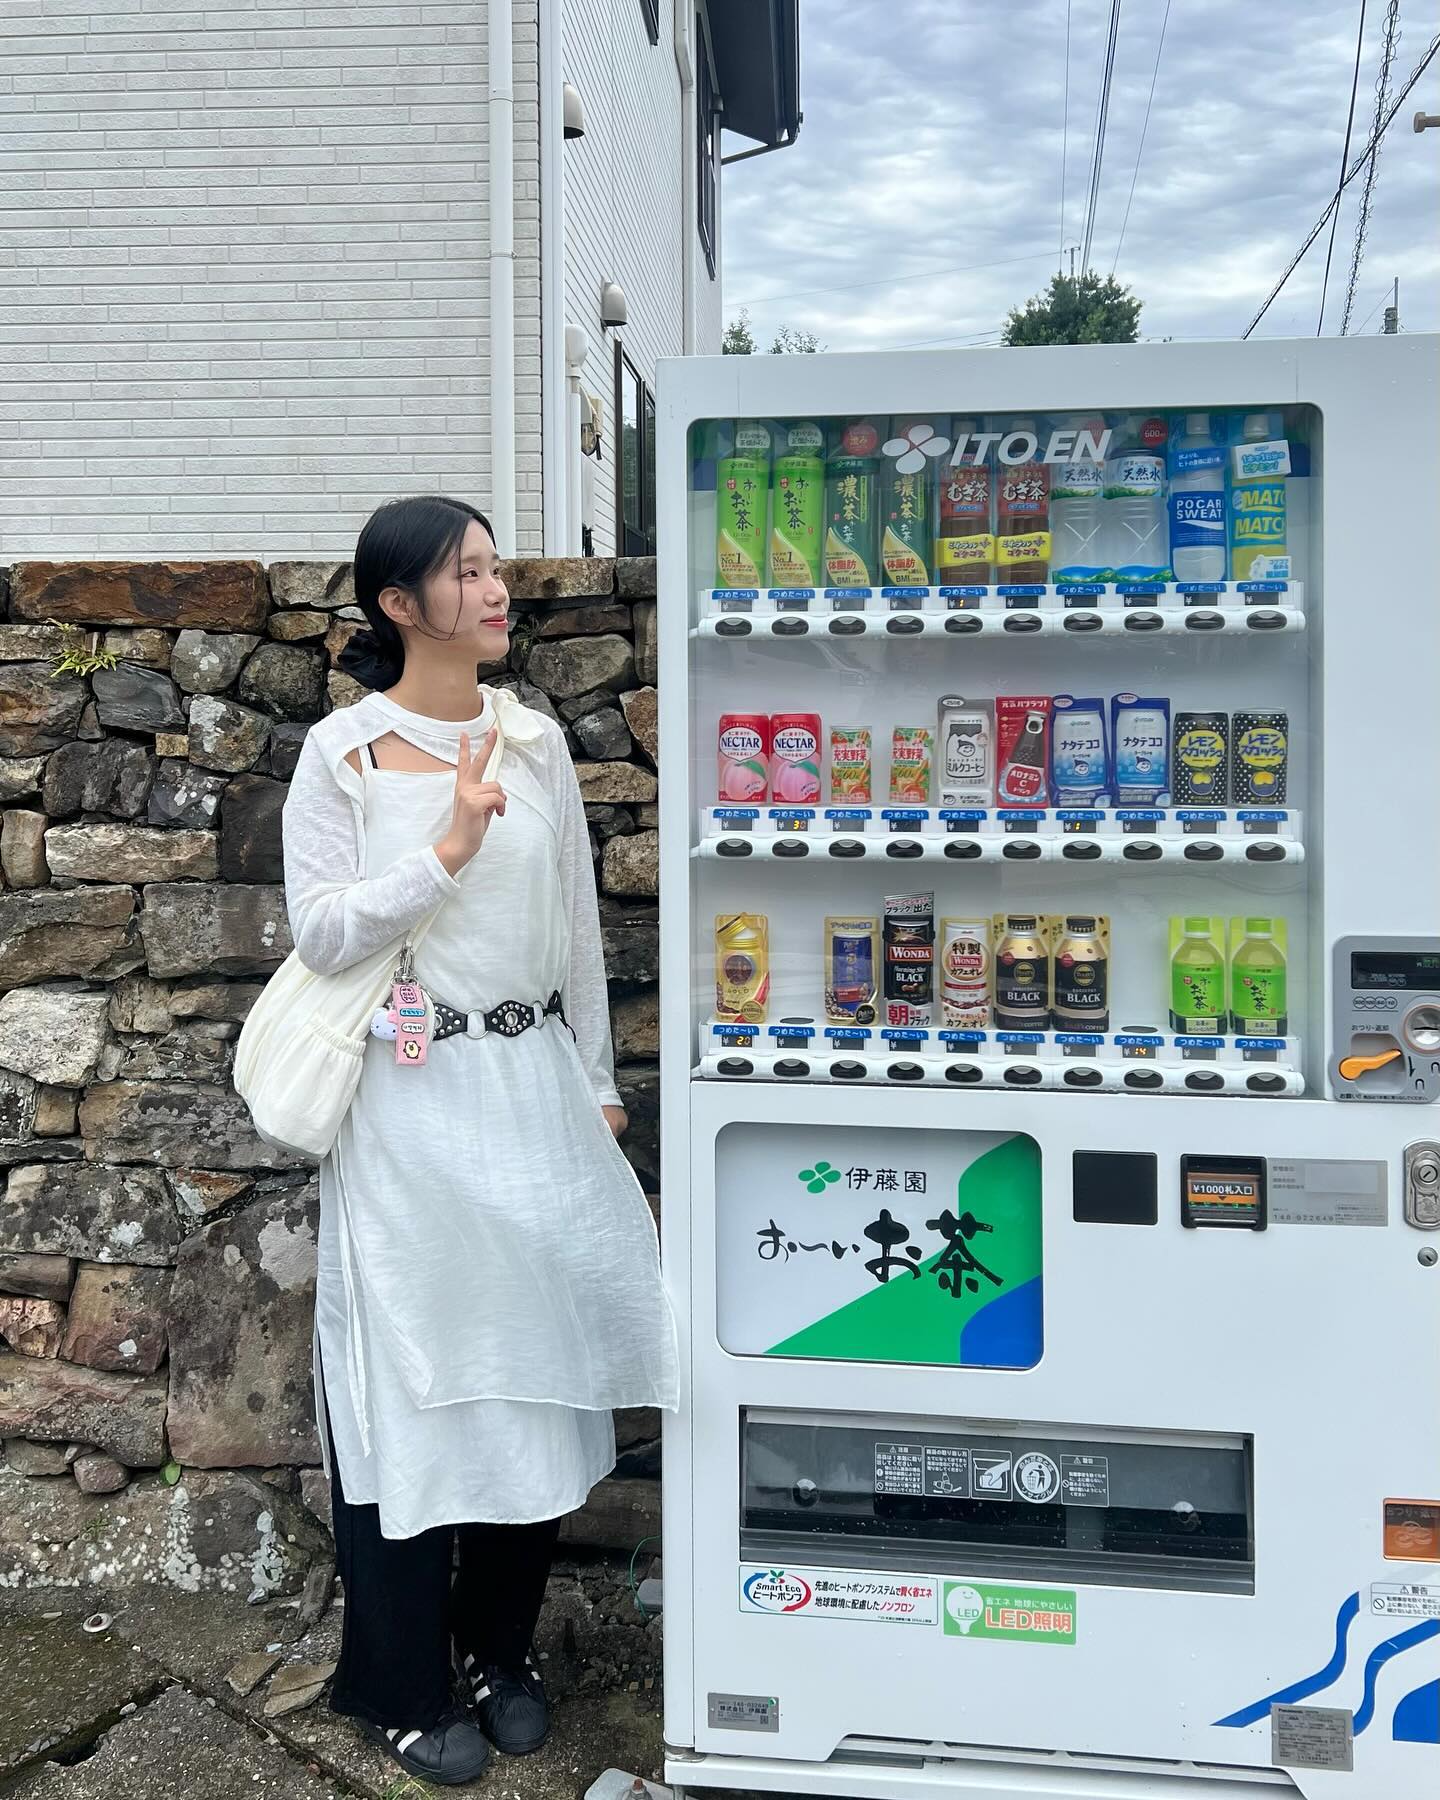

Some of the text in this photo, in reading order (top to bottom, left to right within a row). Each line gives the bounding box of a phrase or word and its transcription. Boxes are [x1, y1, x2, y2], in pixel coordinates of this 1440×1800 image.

[950, 429, 1112, 466] ITO EN
[1065, 467, 1103, 482] 天然水
[1123, 465, 1161, 481] 天然水
[947, 480, 989, 502] むぎ茶
[1002, 479, 1046, 501] むぎ茶
[837, 475, 859, 520] 濃い茶
[1176, 499, 1223, 509] POCAR
[1176, 508, 1222, 519] SWEAT
[721, 552, 741, 564] No.1
[773, 551, 793, 563] No.1
[828, 559, 857, 571] 体脂肪
[887, 558, 915, 570] 体脂肪
[721, 737, 760, 748] NECTAR
[775, 738, 814, 749] NECTAR
[1188, 736, 1218, 747] レモン
[1247, 734, 1281, 745] レモン
[1180, 747, 1223, 757] スカッシュ
[1241, 745, 1285, 756] スカッシュ
[947, 762, 984, 773] ミルクコーヒー
[892, 946, 930, 958] WONDA
[952, 943, 981, 955] 特製
[953, 956, 980, 965] WONDA
[896, 972, 924, 982] BLACK
[950, 967, 982, 976] カフェオレ
[1007, 991, 1040, 1001] BLACK
[1067, 993, 1101, 1003] BLACK
[888, 1004, 908, 1026] 朝
[946, 1019, 986, 1028] カフェオレ
[845, 1166, 927, 1194] 伊藤園
[1193, 1184, 1253, 1195] ¥1000札入口
[756, 1582, 801, 1592] Smart Eco
[1411, 1586, 1428, 1595] 警告
[752, 1590, 802, 1602] ヒートポンプ
[814, 1596, 915, 1613] 地球環境に配慮したノンフロン
[957, 1607, 980, 1618] LED
[985, 1607, 1073, 1634] LED照明
